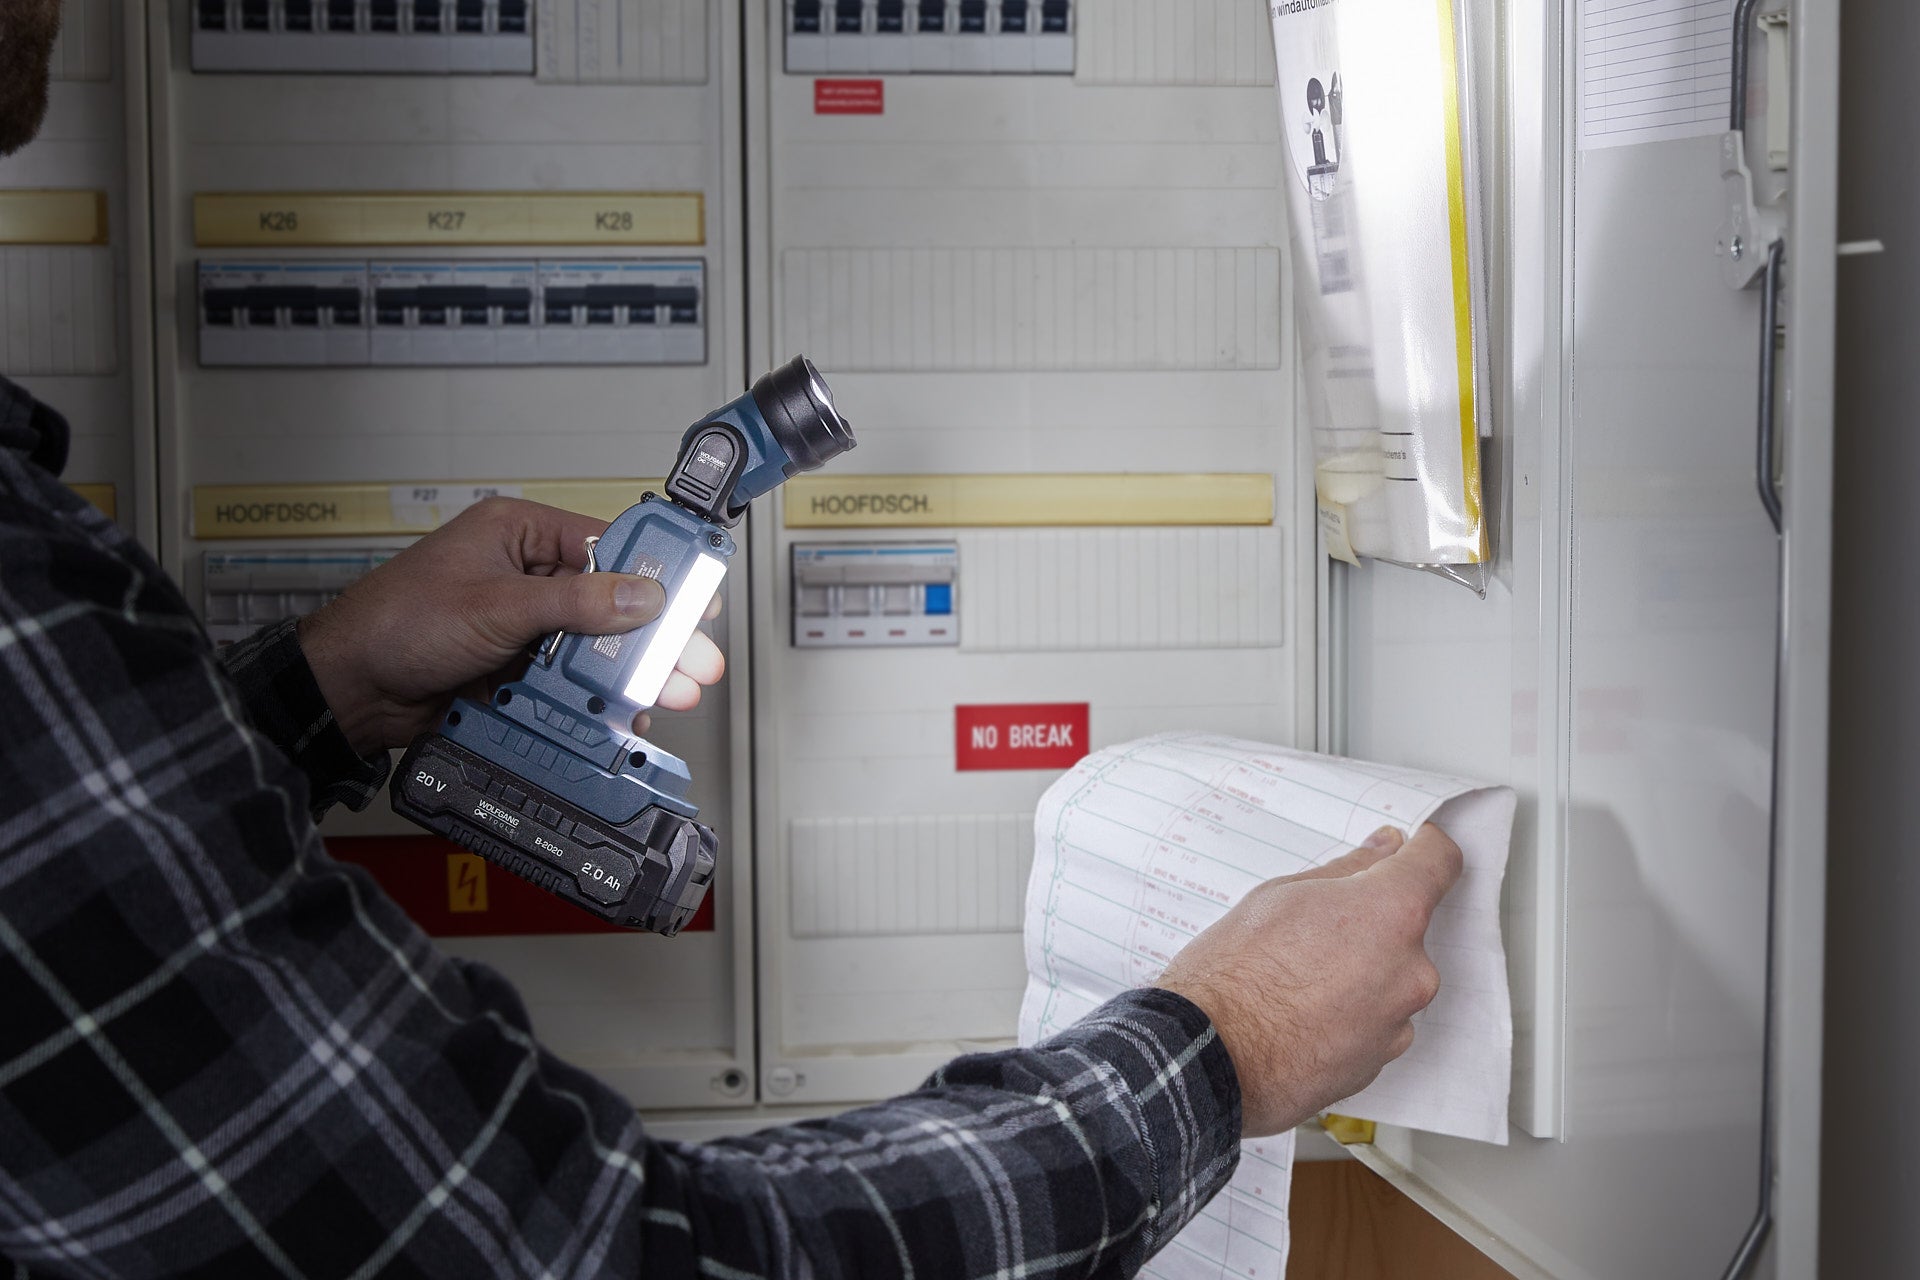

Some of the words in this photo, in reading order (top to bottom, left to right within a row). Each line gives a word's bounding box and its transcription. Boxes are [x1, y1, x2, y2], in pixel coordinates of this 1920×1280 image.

[260, 212, 298, 230] K26
[428, 212, 465, 230] K27
[595, 212, 633, 230] K28
[413, 488, 438, 502] F27
[811, 494, 933, 515] HOOFDSCH.
[971, 725, 998, 749] NO
[1009, 723, 1073, 748] BREAK
[416, 771, 434, 787] 20
[436, 780, 447, 793] V
[479, 799, 520, 826] WOLFGANG
[534, 836, 564, 857] B-2020
[581, 862, 604, 881] 2.0
[603, 875, 621, 891] Ah
